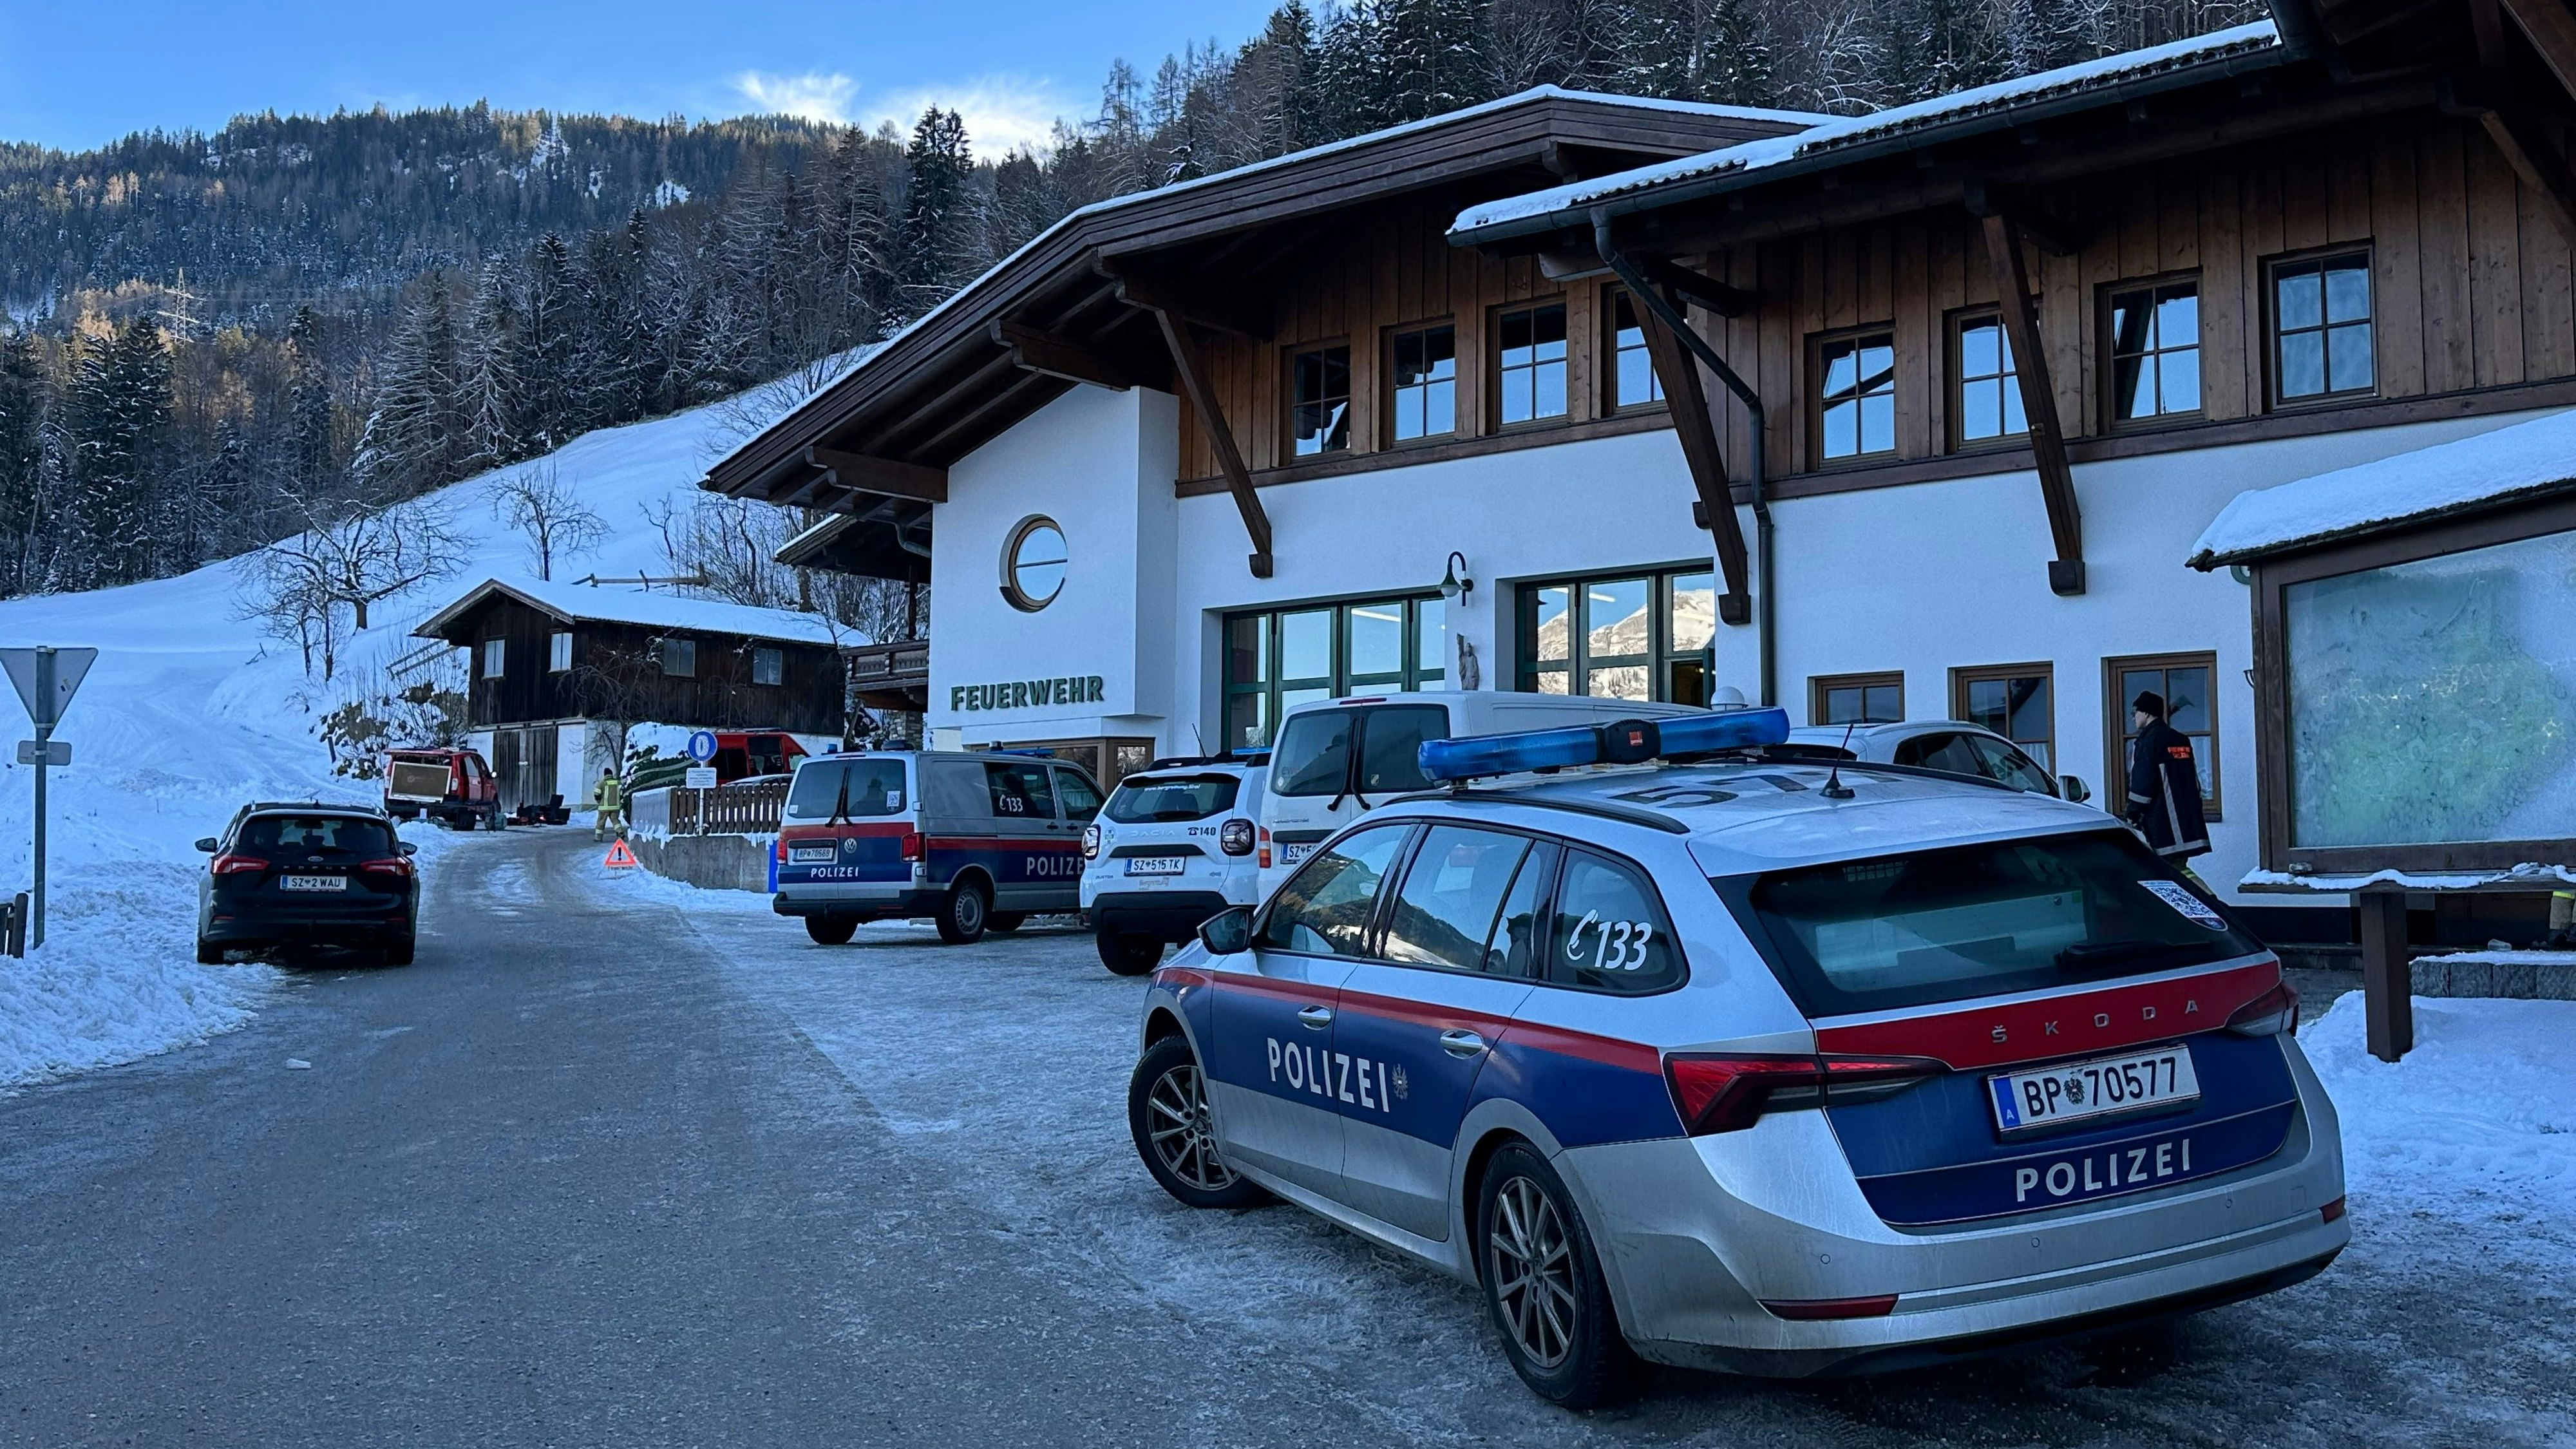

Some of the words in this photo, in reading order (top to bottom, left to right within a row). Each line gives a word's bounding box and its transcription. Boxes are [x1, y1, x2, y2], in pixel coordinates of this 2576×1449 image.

[951, 675, 1104, 712] FEUERWEHR
[1006, 797, 1023, 812] 133
[1200, 827, 1217, 836] 140
[1289, 846, 1300, 857] SZ
[811, 867, 859, 878] POLIZEI
[1027, 857, 1083, 876] POLIZE
[1134, 860, 1144, 871] SZ
[1151, 859, 1166, 870] 515
[1169, 858, 1180, 869] TK
[292, 878, 304, 887] SZ
[311, 878, 317, 887] 2
[320, 878, 341, 887] WAU
[1595, 921, 1653, 971] 133
[1991, 999, 2199, 1043] ŠKODA
[1267, 1037, 1390, 1113] POLIZEI
[2022, 1077, 2061, 1117] BP
[2083, 1056, 2175, 1107] 70577
[2005, 1108, 2015, 1121] A
[2016, 1138, 2190, 1202] POLIZEI
